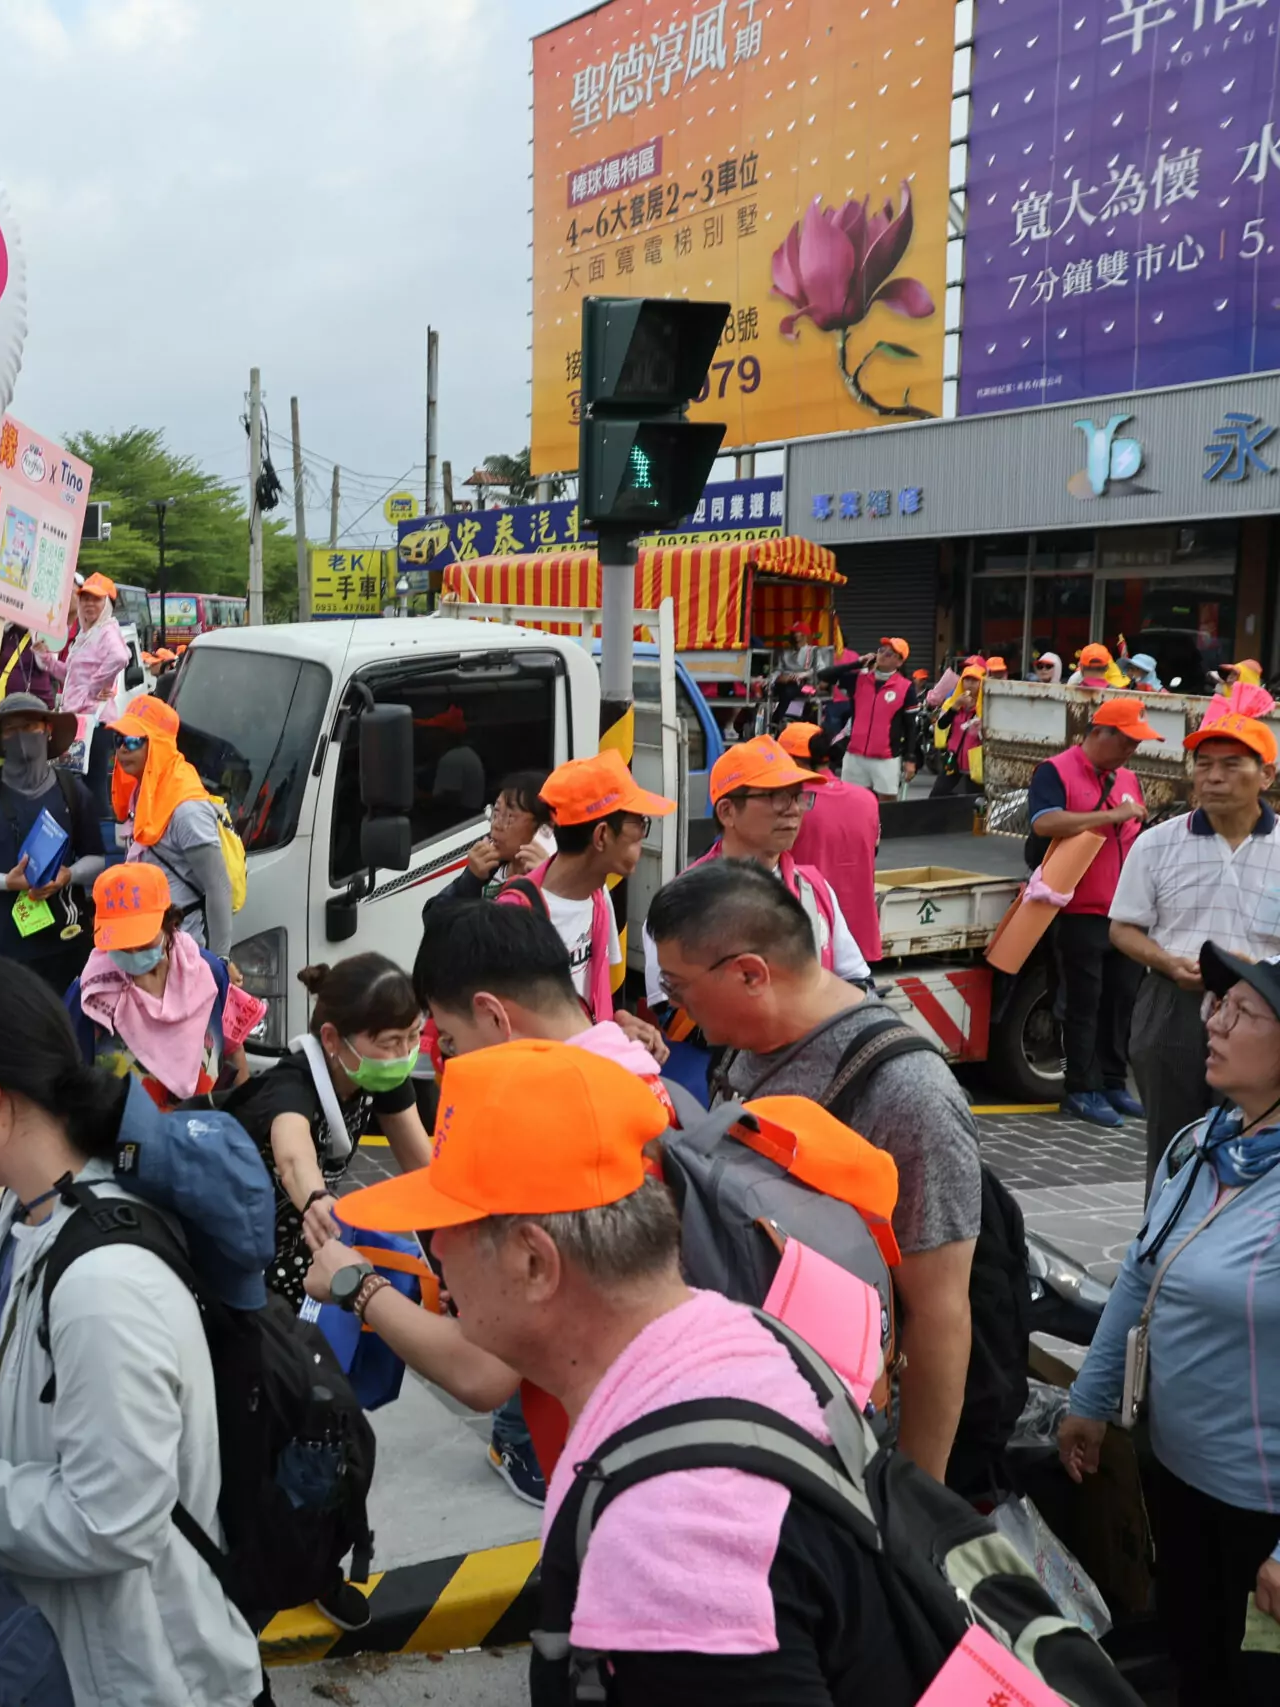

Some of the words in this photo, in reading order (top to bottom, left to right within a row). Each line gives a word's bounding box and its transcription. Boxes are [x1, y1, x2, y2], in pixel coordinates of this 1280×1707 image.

[569, 0, 728, 134] 聖德淳風
[571, 144, 658, 202] 棒球場特區
[1009, 146, 1203, 248] 寬大為懷
[717, 306, 759, 347] 8號
[1202, 412, 1276, 482] 永
[61, 459, 84, 493] Tino
[328, 553, 365, 571] 老K
[314, 574, 378, 600] 二手車
